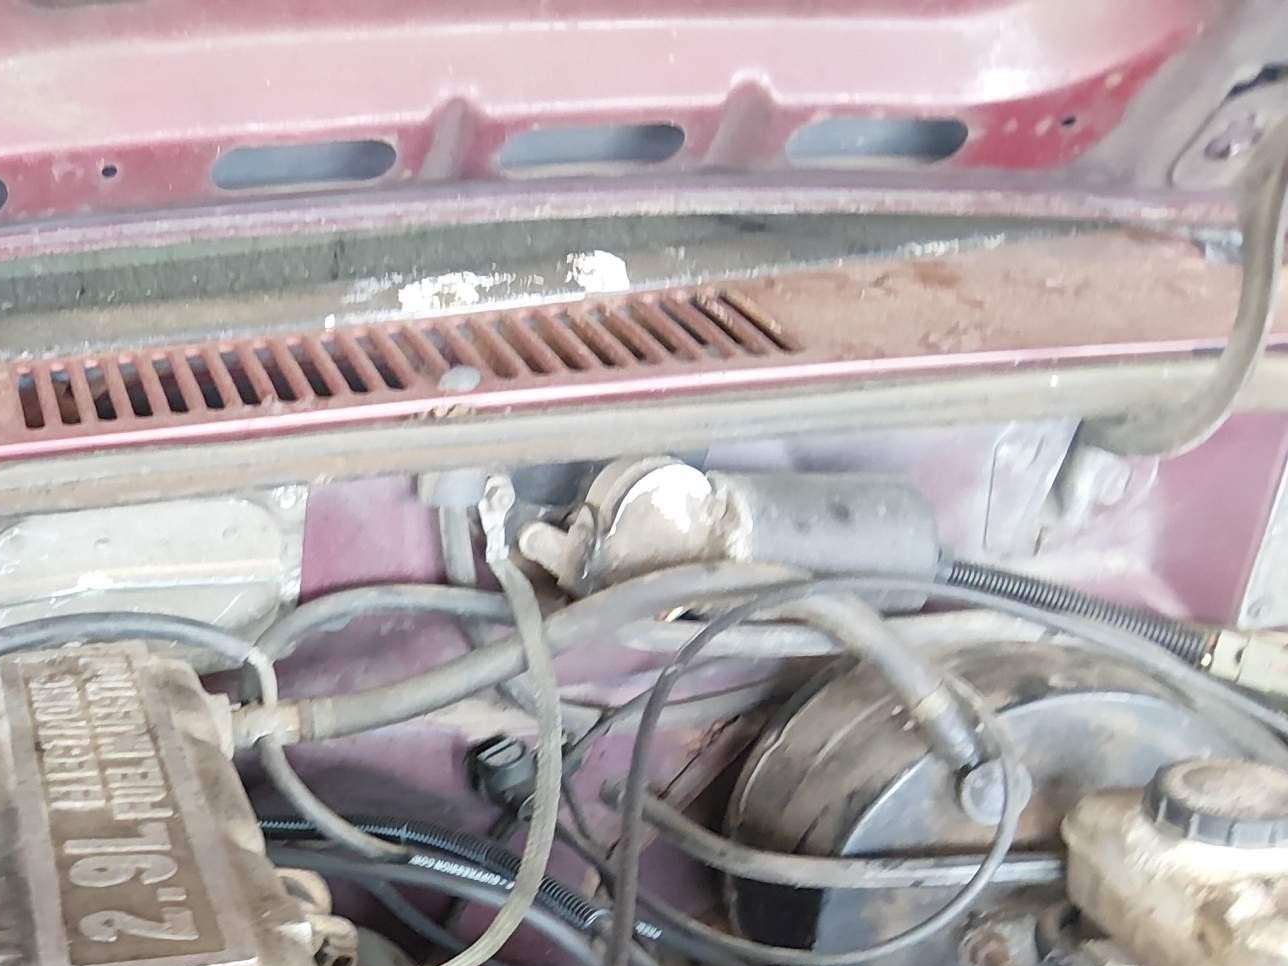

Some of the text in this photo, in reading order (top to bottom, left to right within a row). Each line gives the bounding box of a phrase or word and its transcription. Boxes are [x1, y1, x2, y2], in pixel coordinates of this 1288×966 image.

[28, 674, 106, 811] ELECTRONIC
[105, 766, 174, 821] FUEL
[63, 822, 200, 942] 2.9L
